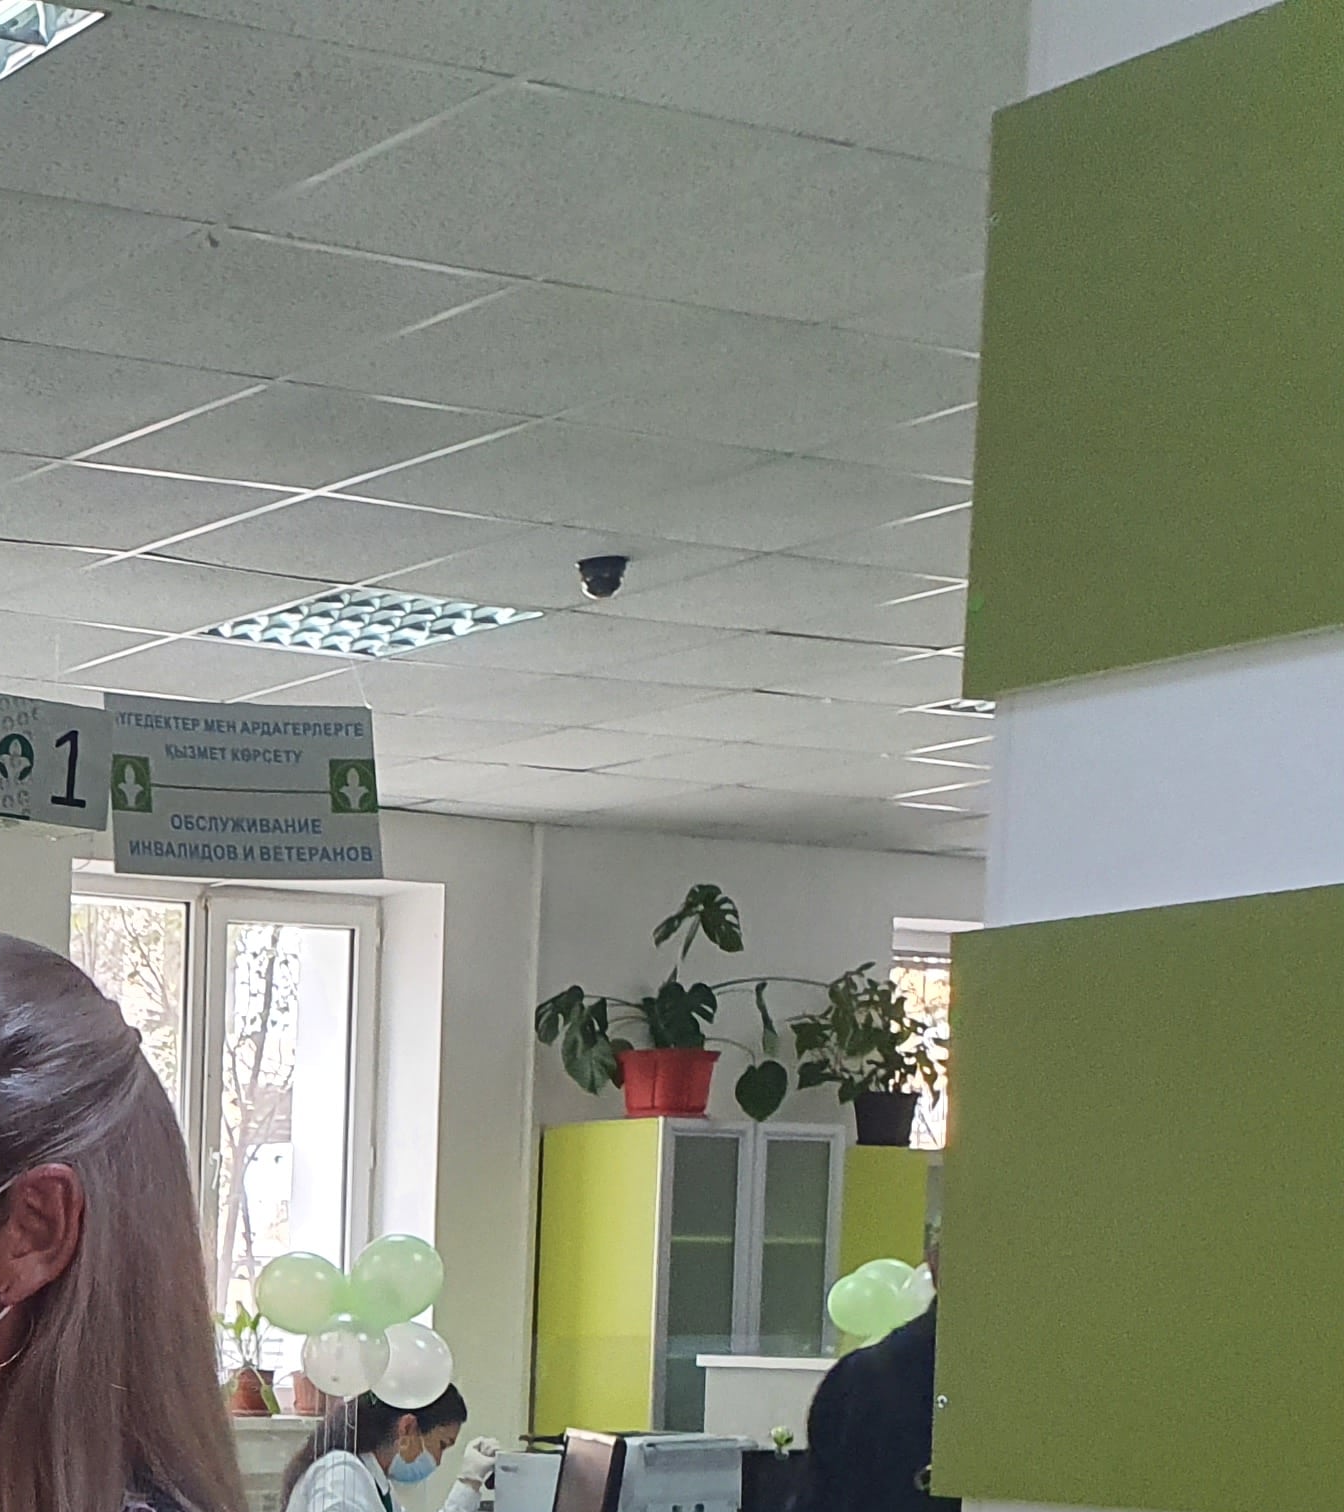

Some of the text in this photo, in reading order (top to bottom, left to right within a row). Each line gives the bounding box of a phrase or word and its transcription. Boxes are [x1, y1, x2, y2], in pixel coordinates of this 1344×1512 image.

[116, 712, 363, 737] ҮГЕДЕКТЕР МЕН АРДАГЕРЛЕРГЕ
[50, 730, 87, 808] 1
[170, 813, 322, 835] ОБСЛУЖИВАНИЕ
[129, 840, 373, 862] ИНВАЛИДОВ И ВЕТЕРАНОВ
